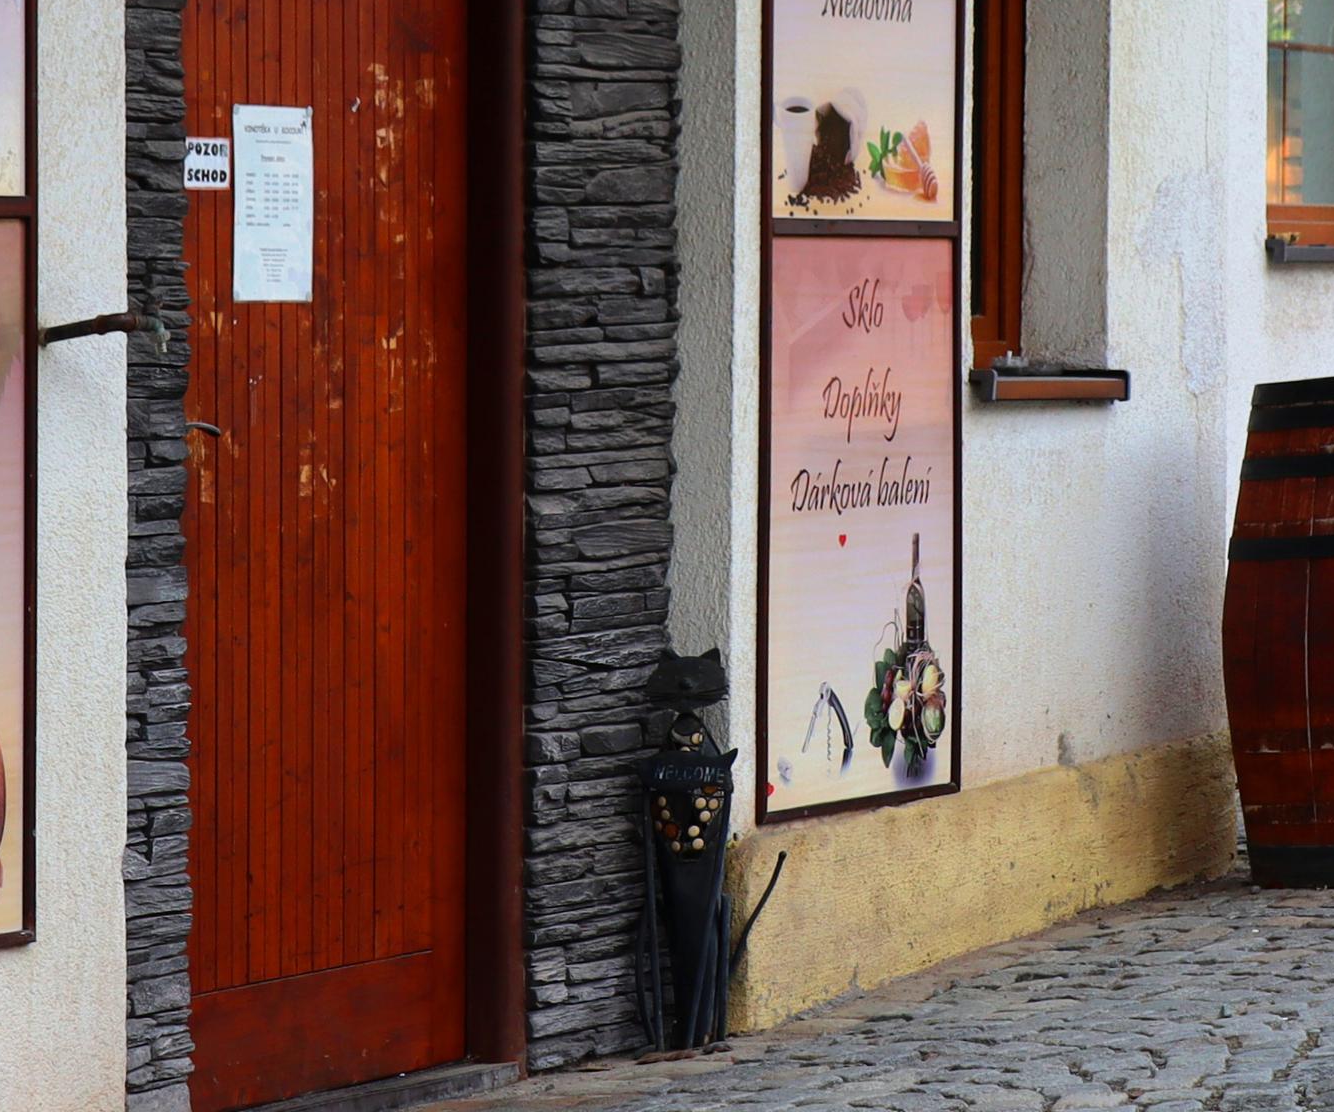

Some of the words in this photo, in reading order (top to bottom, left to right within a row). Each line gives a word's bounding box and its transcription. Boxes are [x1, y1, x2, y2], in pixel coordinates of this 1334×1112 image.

[187, 142, 228, 157] POZOR
[187, 168, 227, 183] SCHOD
[842, 278, 884, 333] Sklo
[822, 367, 902, 444] Doplňky
[790, 458, 872, 516] Dárková
[876, 455, 932, 507] balení
[652, 764, 725, 784] WELCOME
